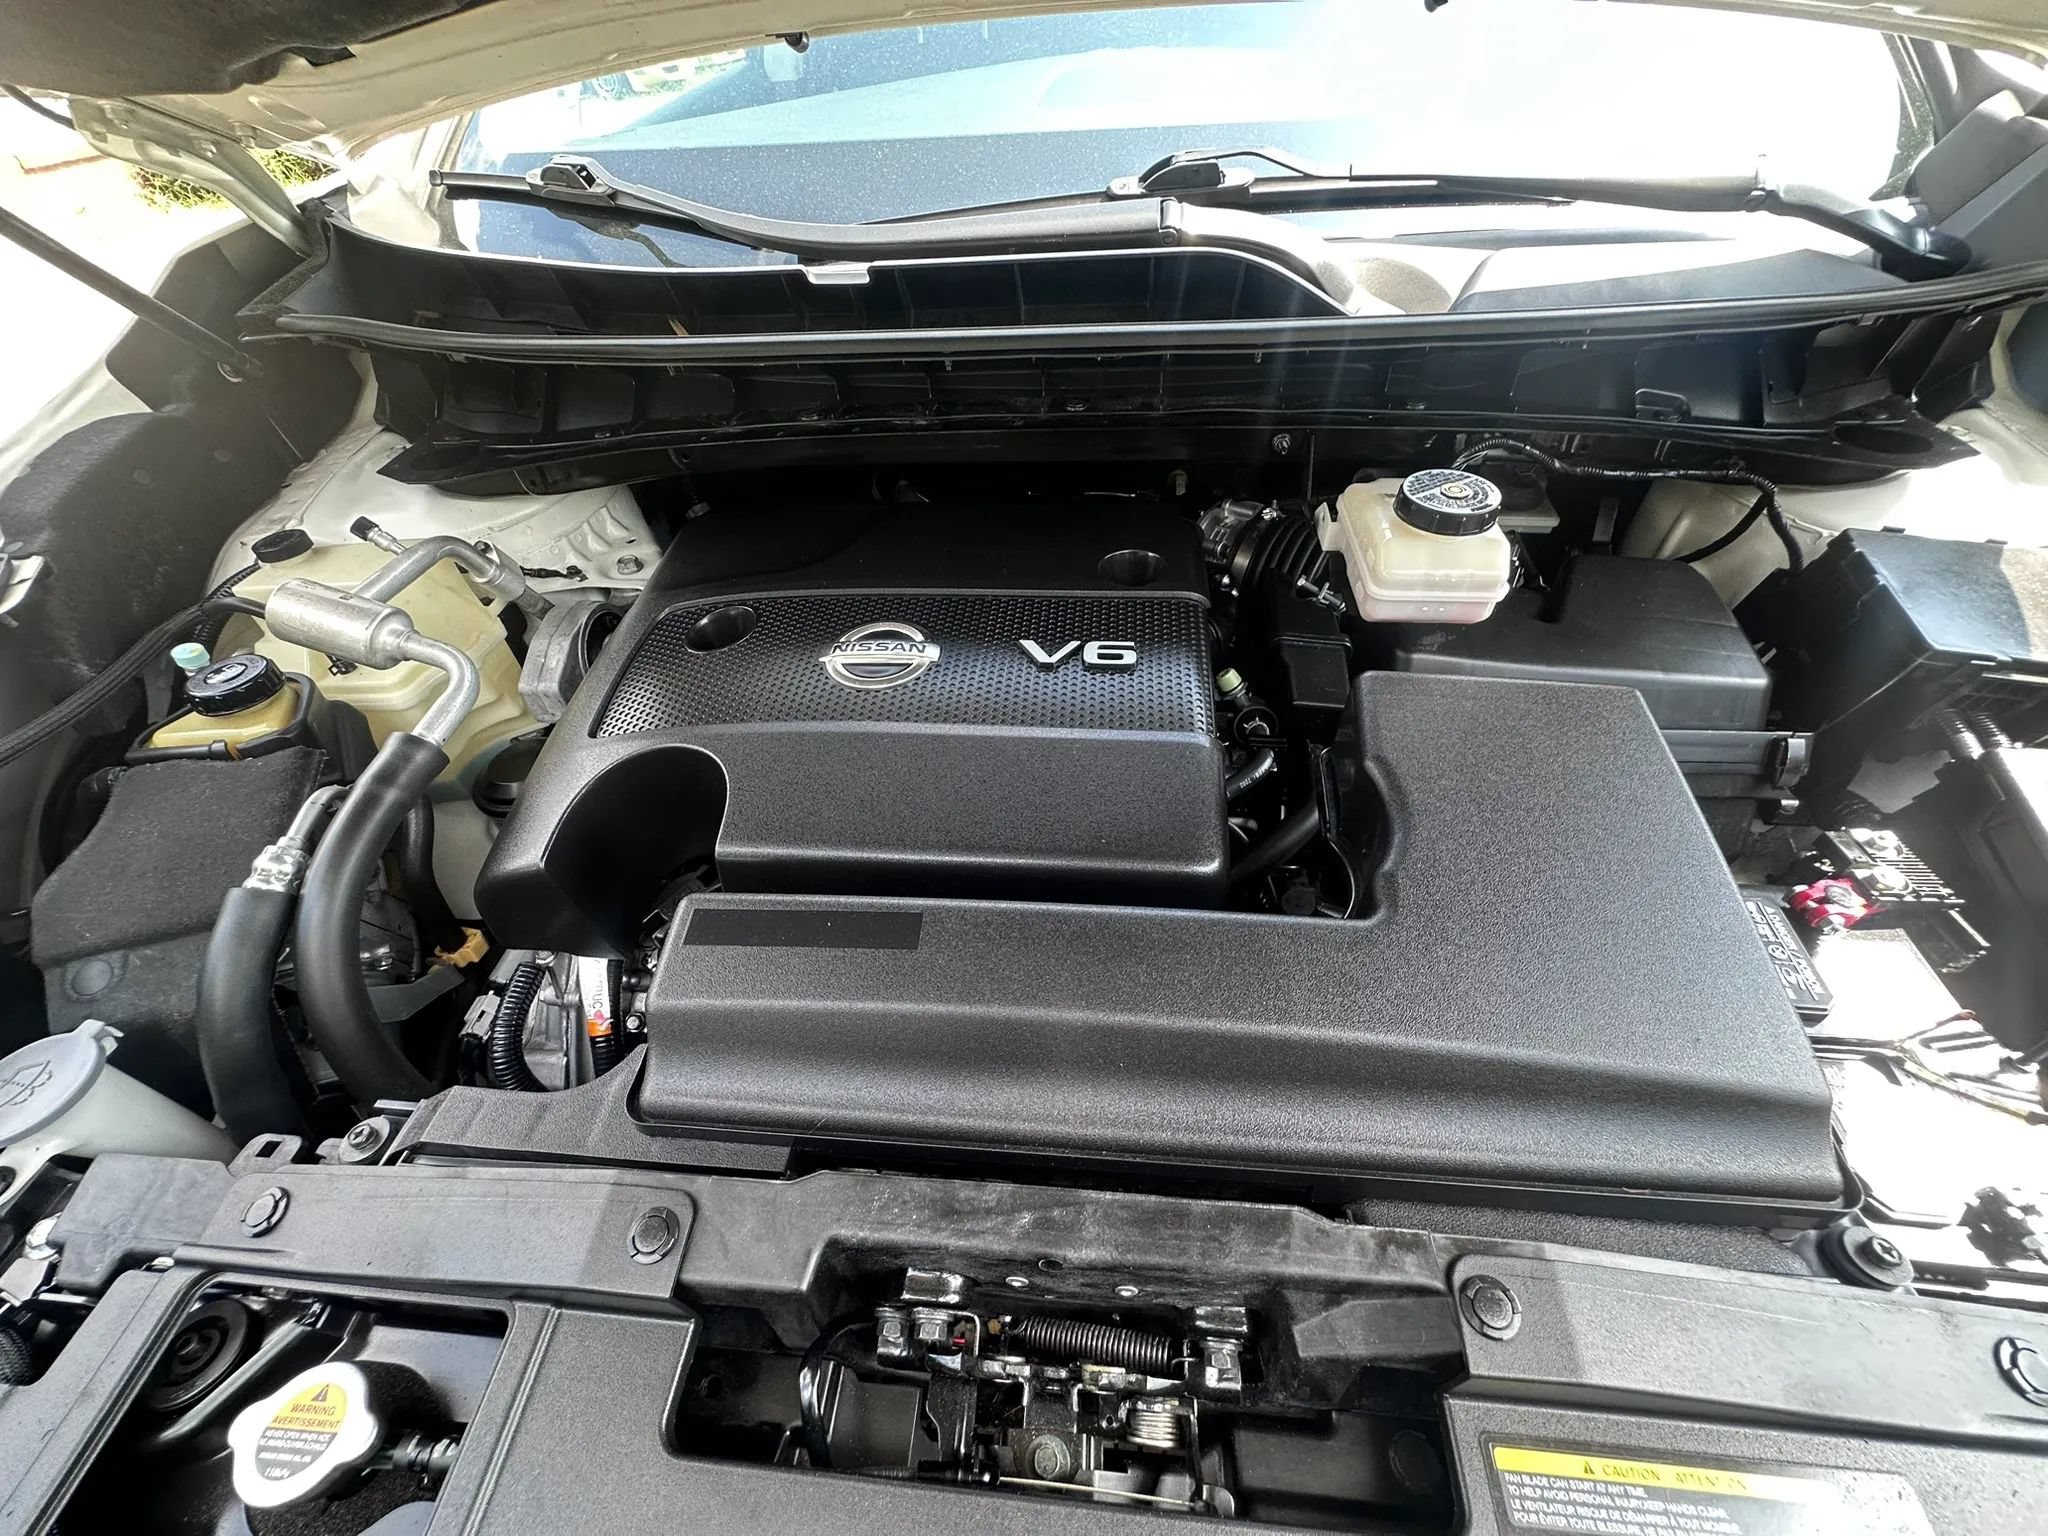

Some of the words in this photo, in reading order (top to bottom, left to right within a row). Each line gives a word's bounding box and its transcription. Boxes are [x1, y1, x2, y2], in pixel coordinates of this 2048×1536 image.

[832, 641, 928, 655] NISSAN
[1018, 639, 1137, 670] V6
[290, 1403, 336, 1416] WARNING
[271, 1415, 342, 1429] AVERTISSEMENT
[1602, 1464, 1660, 1481] CAUTION
[1504, 1473, 1522, 1485] FAN
[1522, 1474, 1550, 1488] BLADE
[1549, 1478, 1569, 1489] CAN
[1569, 1479, 1594, 1492] START
[1595, 1482, 1607, 1493] AT
[1607, 1483, 1625, 1495] ANY
[1507, 1485, 1520, 1496] TO
[1520, 1487, 1543, 1498] HELP
[1543, 1488, 1570, 1501] AVOID
[1569, 1491, 1615, 1507] PERSONAL
[1510, 1499, 1523, 1510] LE
[1521, 1500, 1577, 1516] VENTILATEUR
[1576, 1506, 1609, 1521] RISQUE
[1608, 1508, 1622, 1522] DE
[1677, 1517, 1701, 1530] TOUT
[1513, 1511, 1539, 1524] POUR
[1538, 1511, 1569, 1527] ÉVITER
[1568, 1517, 1598, 1531] TOUTE
